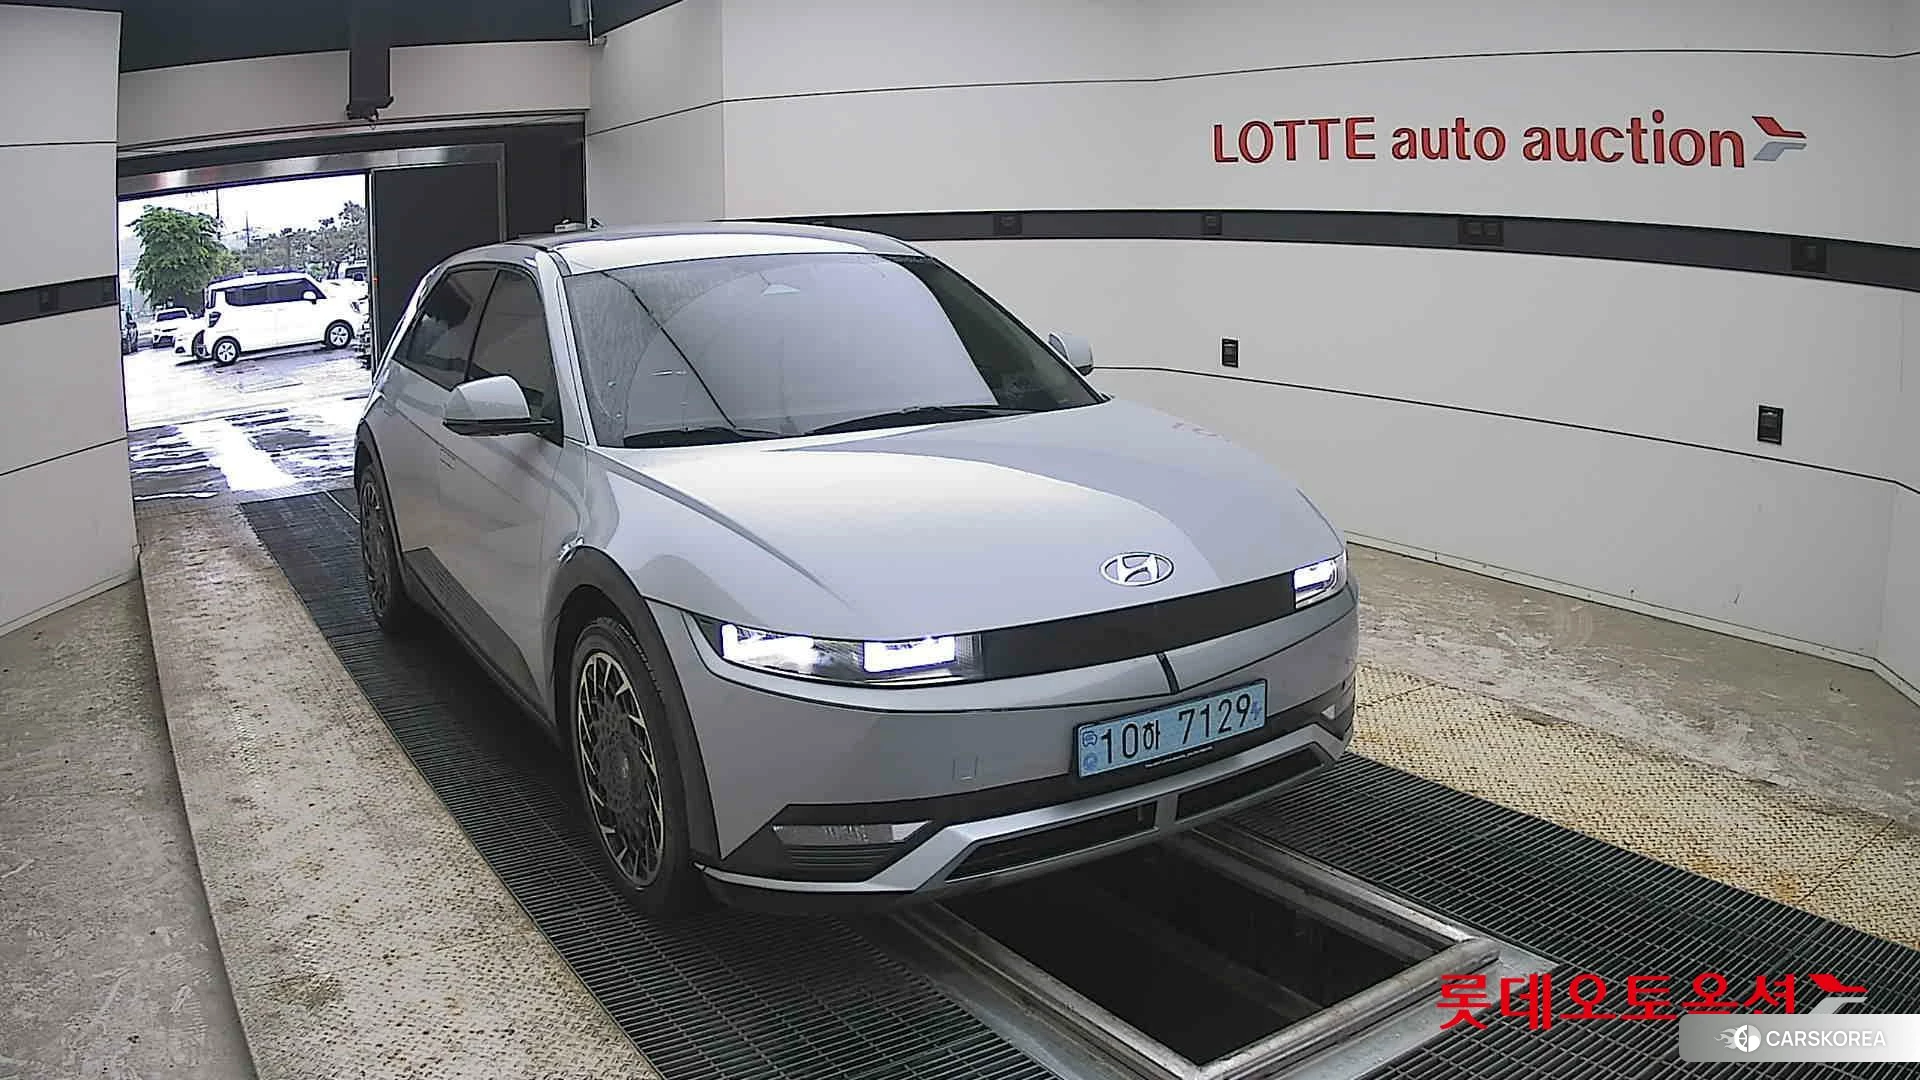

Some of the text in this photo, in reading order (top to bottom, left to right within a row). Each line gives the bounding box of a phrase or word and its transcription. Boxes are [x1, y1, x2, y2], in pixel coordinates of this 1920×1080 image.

[1212, 109, 1746, 168] LOTTE auto auction
[1100, 693, 1252, 764] 10하 7129
